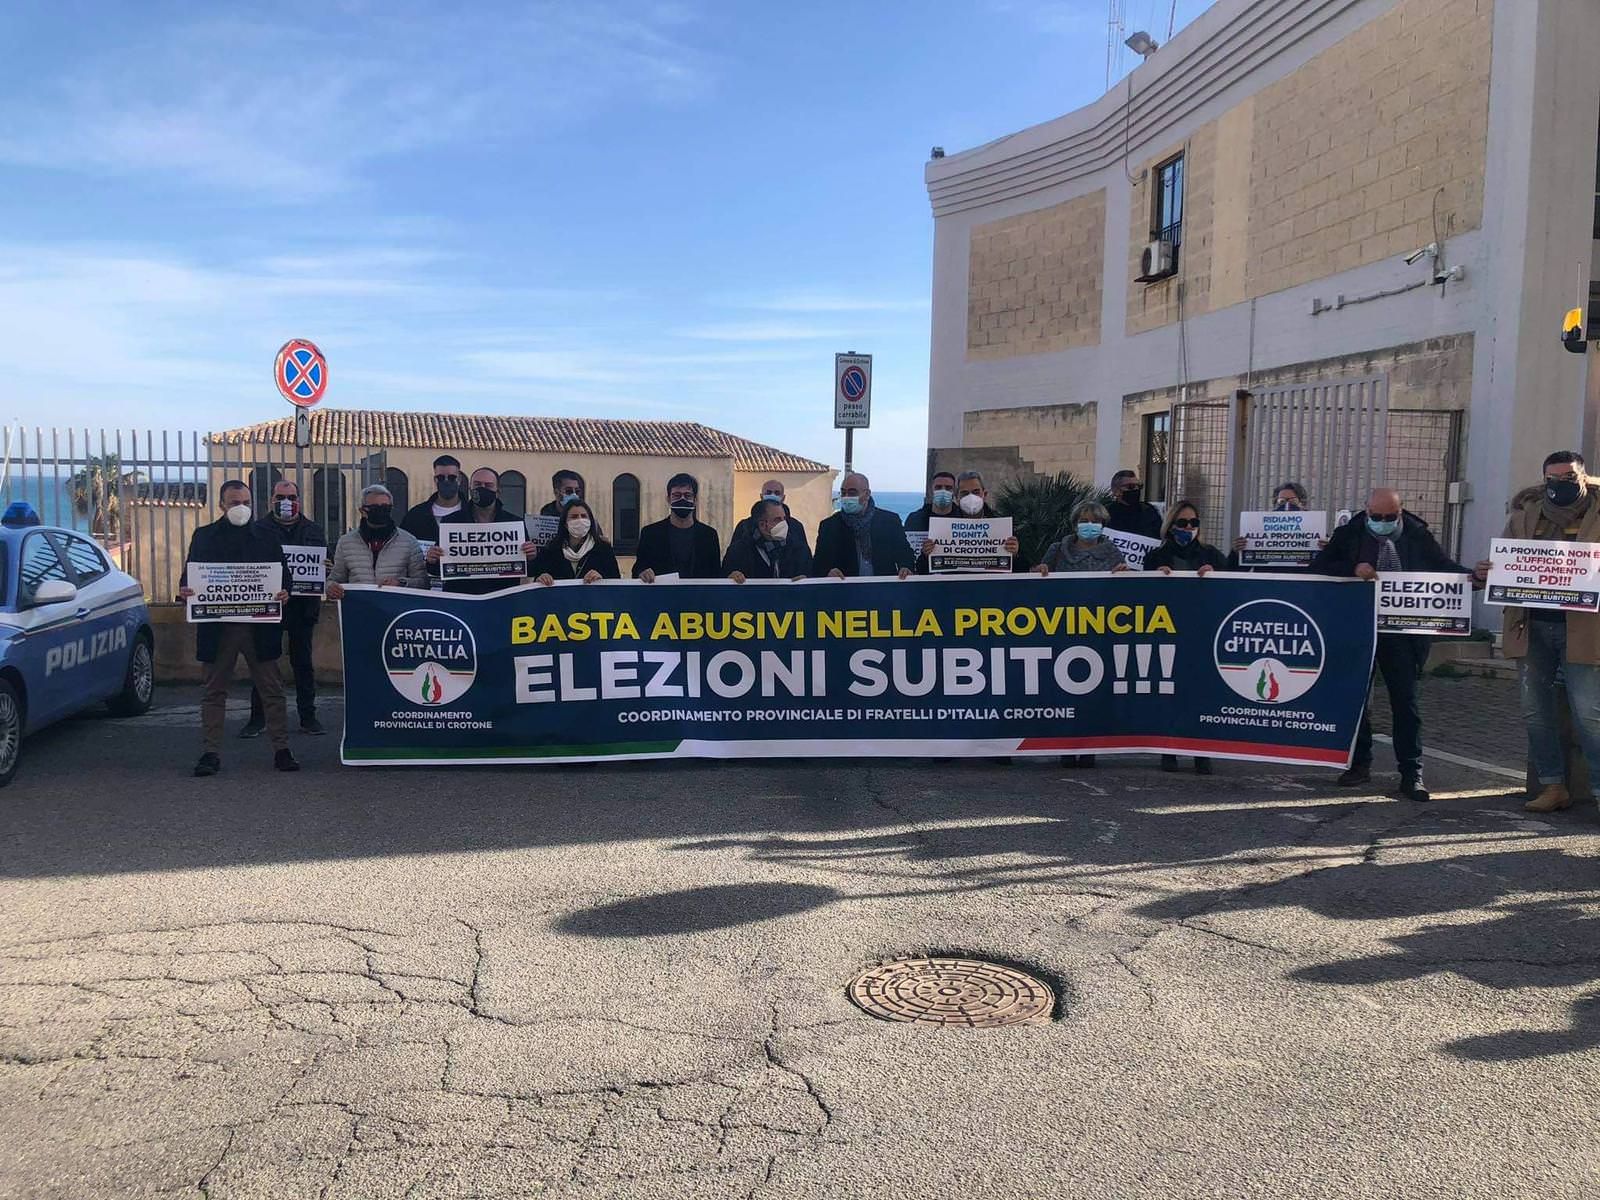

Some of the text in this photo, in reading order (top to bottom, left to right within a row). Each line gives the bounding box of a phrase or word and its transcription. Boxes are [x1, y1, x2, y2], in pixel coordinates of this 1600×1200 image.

[838, 410, 867, 418] carrabile
[951, 522, 990, 531] RIDIAMO
[449, 531, 519, 543] ELEZIONI
[934, 538, 957, 546] ALLA
[1245, 532, 1321, 540] ALLA PROVINCIA
[1254, 540, 1311, 548] DI CROTONE
[449, 545, 519, 557] SUBITO!!!
[1495, 546, 1508, 554] LA
[1510, 547, 1565, 557] PROVINCIA
[1567, 550, 1591, 559] NON
[1516, 556, 1577, 566] L'UFFICIO DI
[1504, 563, 1588, 576] COLLOCAMENTO
[1516, 575, 1573, 587] DEL PD!!!
[207, 584, 265, 593] CROTONE
[1381, 581, 1464, 595] ELEZIONI
[198, 593, 274, 602] QUANDO!!!??
[1506, 591, 1541, 600] ELEZIONI
[1380, 596, 1463, 610] SUBITO!!!
[511, 605, 1177, 645] BASTA ABUSIVI NELLA PROVINCIA
[1232, 621, 1308, 636] FRATELLI
[395, 628, 463, 641] FRATELLI
[46, 625, 127, 678] POLIZIA
[391, 643, 468, 660] d'ITALIA
[1224, 636, 1315, 656] d'ITALIA
[513, 643, 1176, 704] ELEZIONI SUBITO!!!
[391, 711, 473, 720] COORDINAMENTO
[617, 706, 1076, 724] COORDINAMENTO PROVINCIALE DI FRATELLI D'ITALIA CROTONE
[1220, 706, 1315, 720] COORDINAMENTO
[374, 721, 493, 729] PROVINCIALE DI CROTONE
[1199, 714, 1337, 733] PROVINCIALE DI CROTONE
